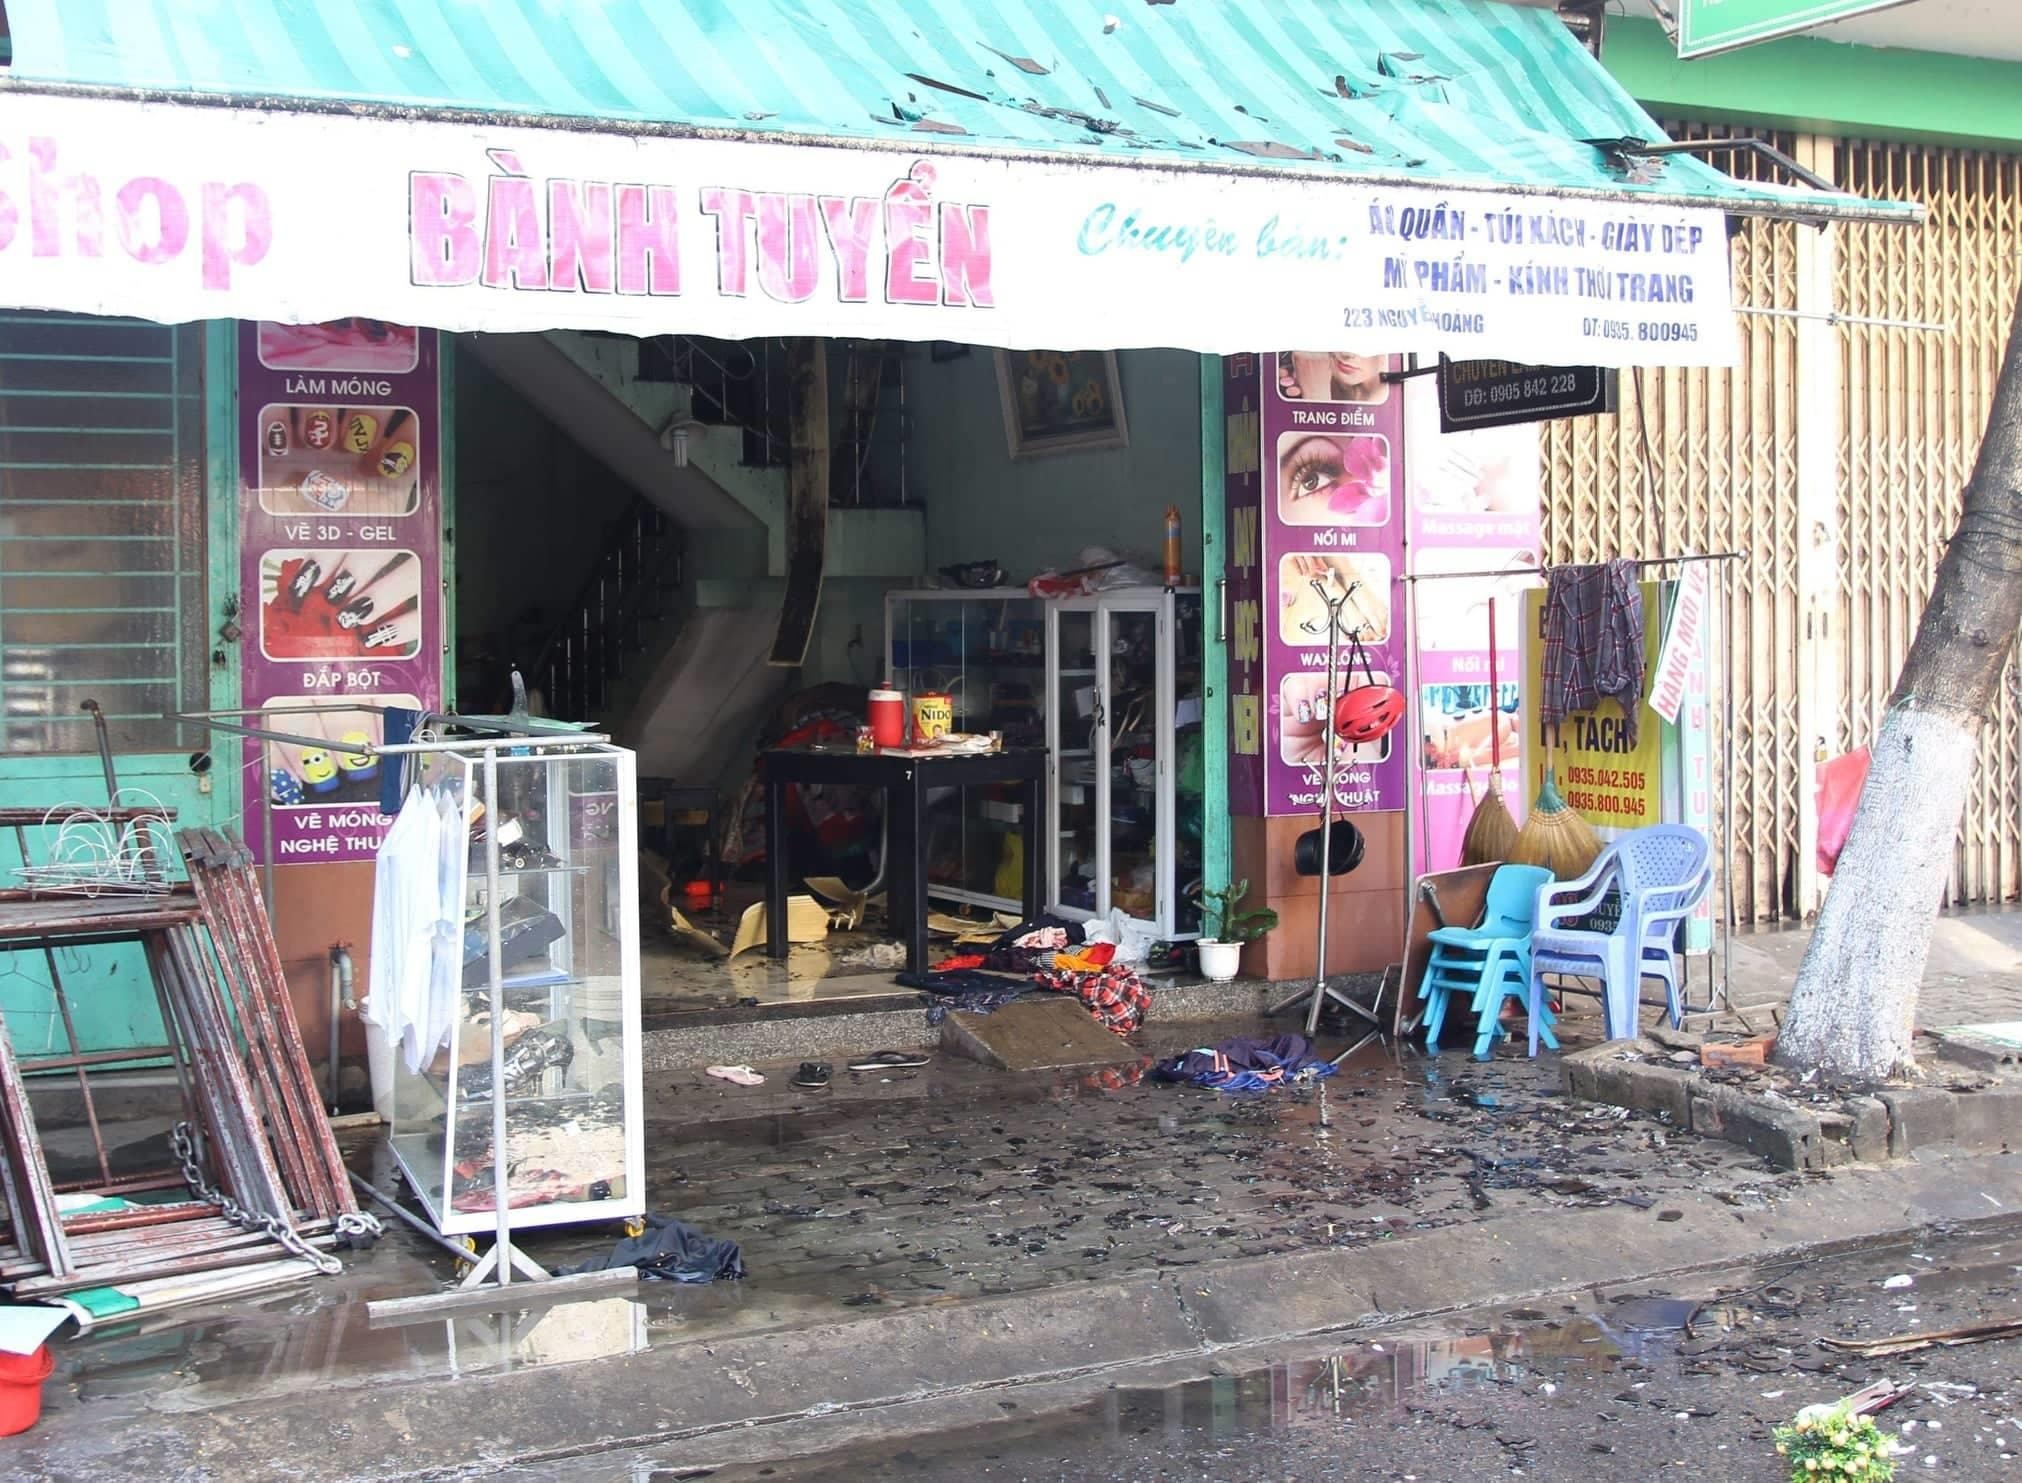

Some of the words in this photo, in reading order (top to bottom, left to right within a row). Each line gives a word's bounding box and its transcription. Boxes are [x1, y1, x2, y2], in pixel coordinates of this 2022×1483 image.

[0, 136, 273, 291] hop
[409, 149, 682, 297] BÀNH
[699, 159, 996, 308] TUYỂN
[1400, 201, 1465, 241] QUẦN
[1484, 206, 1522, 244] TÚI
[1602, 215, 1655, 252] GIÀY
[1662, 218, 1702, 254] DÉP
[1414, 250, 1486, 294] PHẨM
[1616, 272, 1694, 303] TRANG
[1344, 307, 1373, 327] 223
[1638, 322, 1698, 342] 800945
[286, 375, 326, 394] LÀM
[331, 376, 392, 396] MÓNG
[1490, 383, 1521, 403] 0905
[1523, 377, 1547, 398] 842
[1551, 373, 1576, 394] 228
[1292, 410, 1337, 425] TRANG
[1341, 407, 1375, 426] ĐIỂM
[317, 526, 341, 540] 3D
[360, 526, 397, 541] GEL
[1313, 527, 1338, 546] NỐI
[1341, 532, 1357, 546] MI
[303, 665, 342, 688] ĐẮP
[347, 668, 381, 690] BỘT
[294, 812, 322, 829] VẼ
[328, 810, 393, 829] MÓNG
[280, 834, 339, 855] NGHỆ
